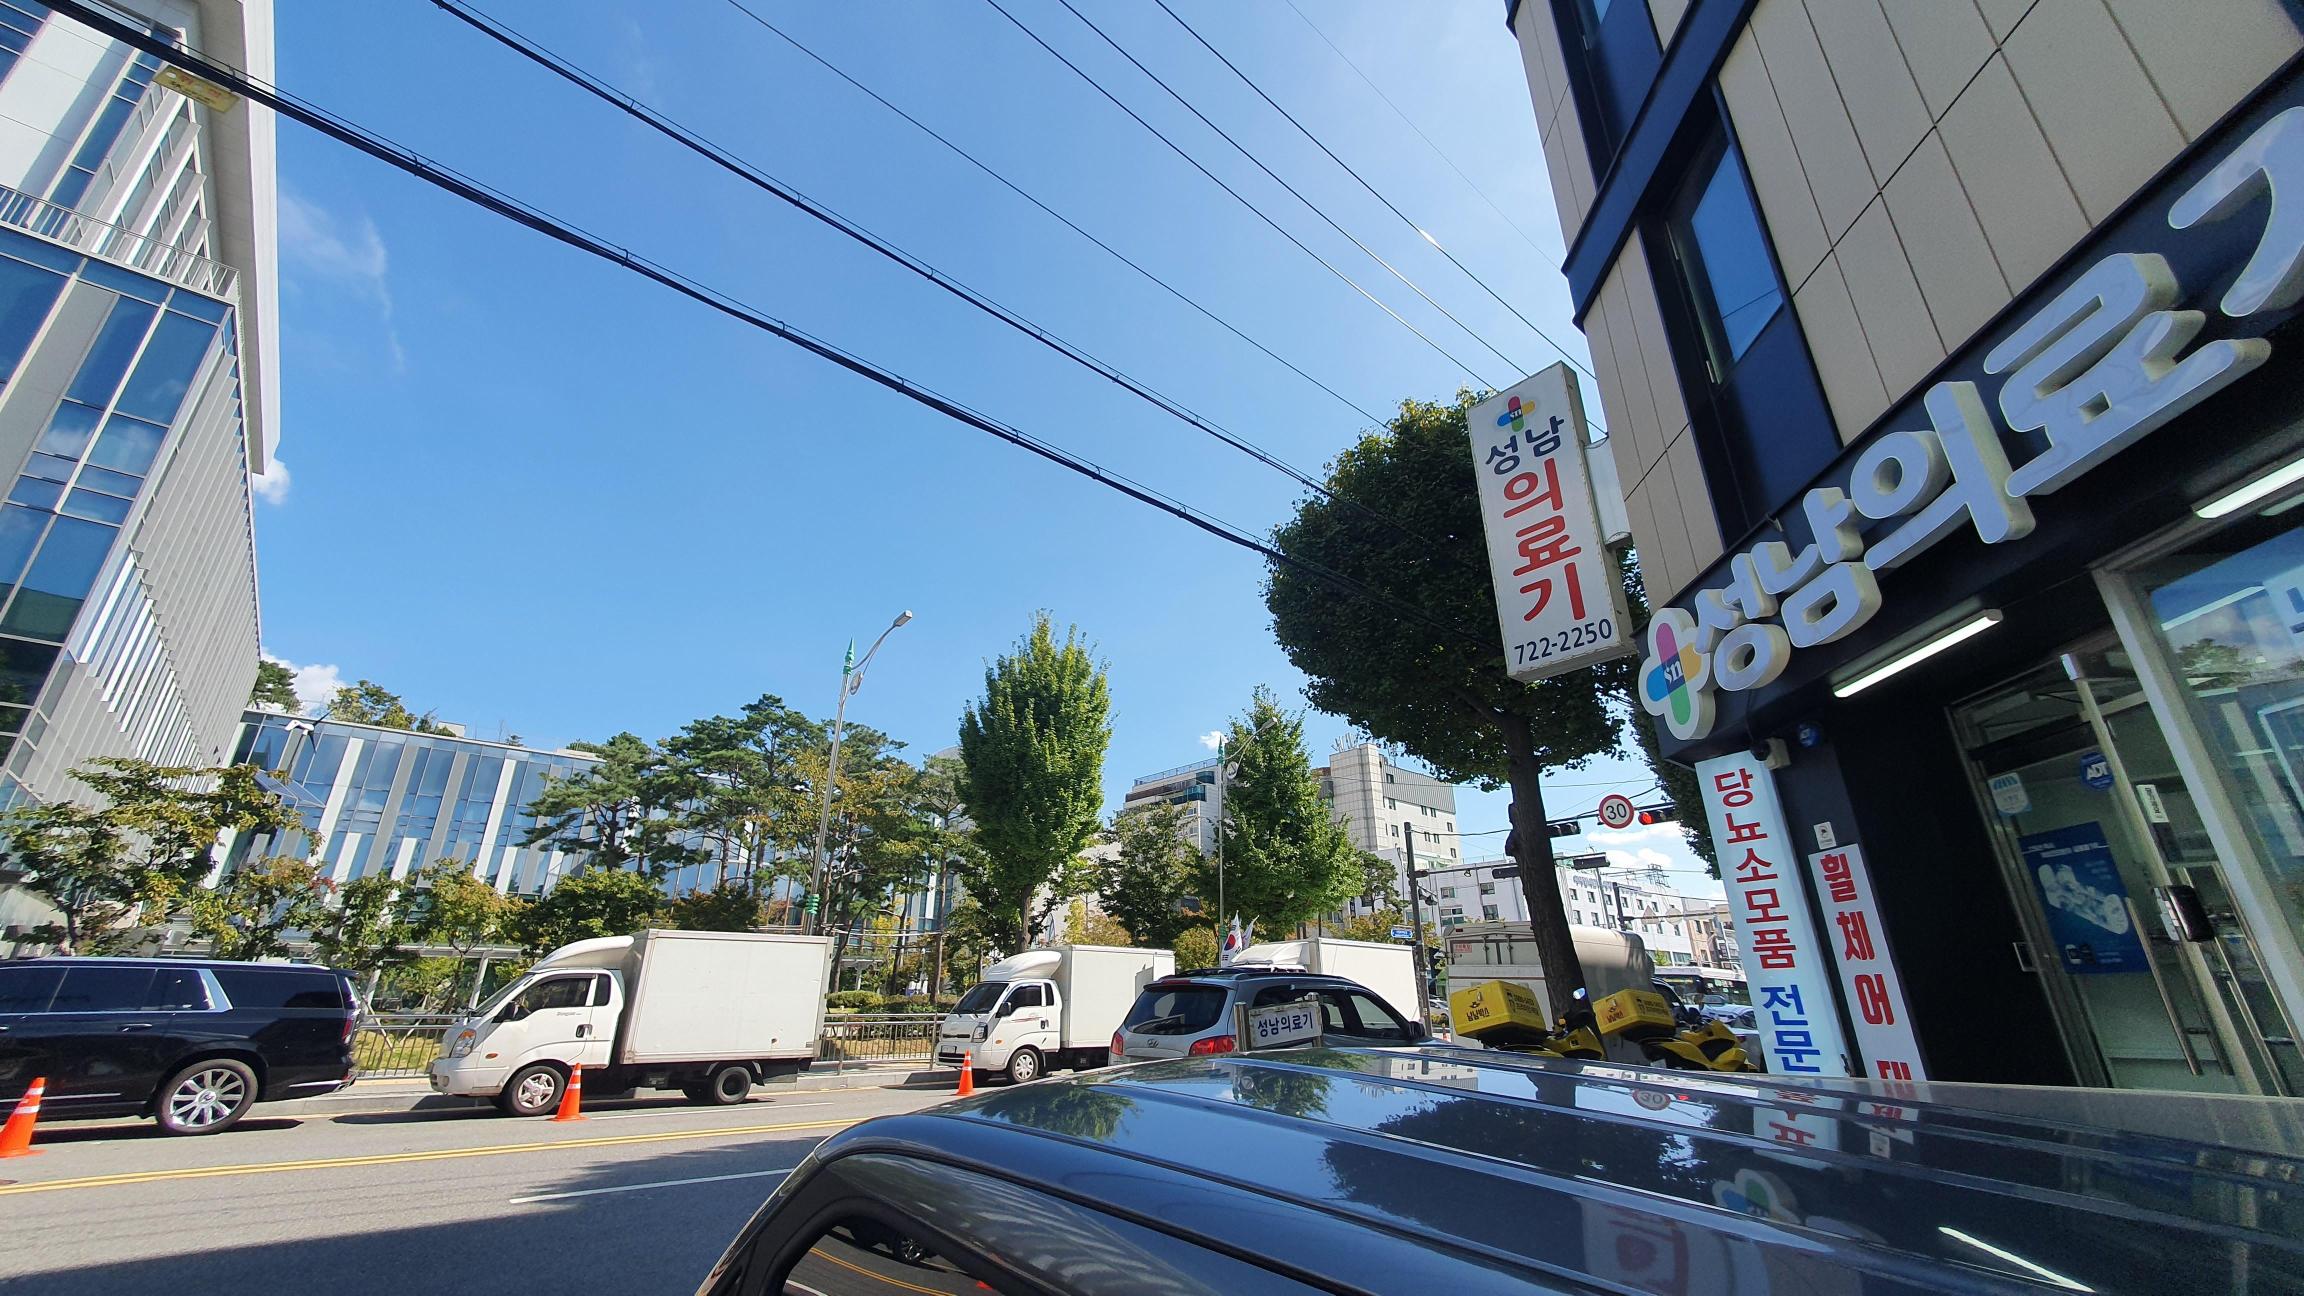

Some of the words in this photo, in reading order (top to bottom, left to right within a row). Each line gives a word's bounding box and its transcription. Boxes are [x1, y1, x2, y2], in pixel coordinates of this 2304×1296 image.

[1485, 415, 1565, 476] 성남
[1503, 457, 1586, 622] 의료기
[1514, 618, 1612, 665] 722-2250
[2086, 761, 2108, 780] ADT
[1605, 803, 1627, 820] 30
[1713, 767, 1797, 970] 당뇨소모품
[1760, 984, 1822, 1074] 전문
[1819, 853, 1895, 1026] 휠체어
[1257, 1012, 1313, 1038] 성남의료기
